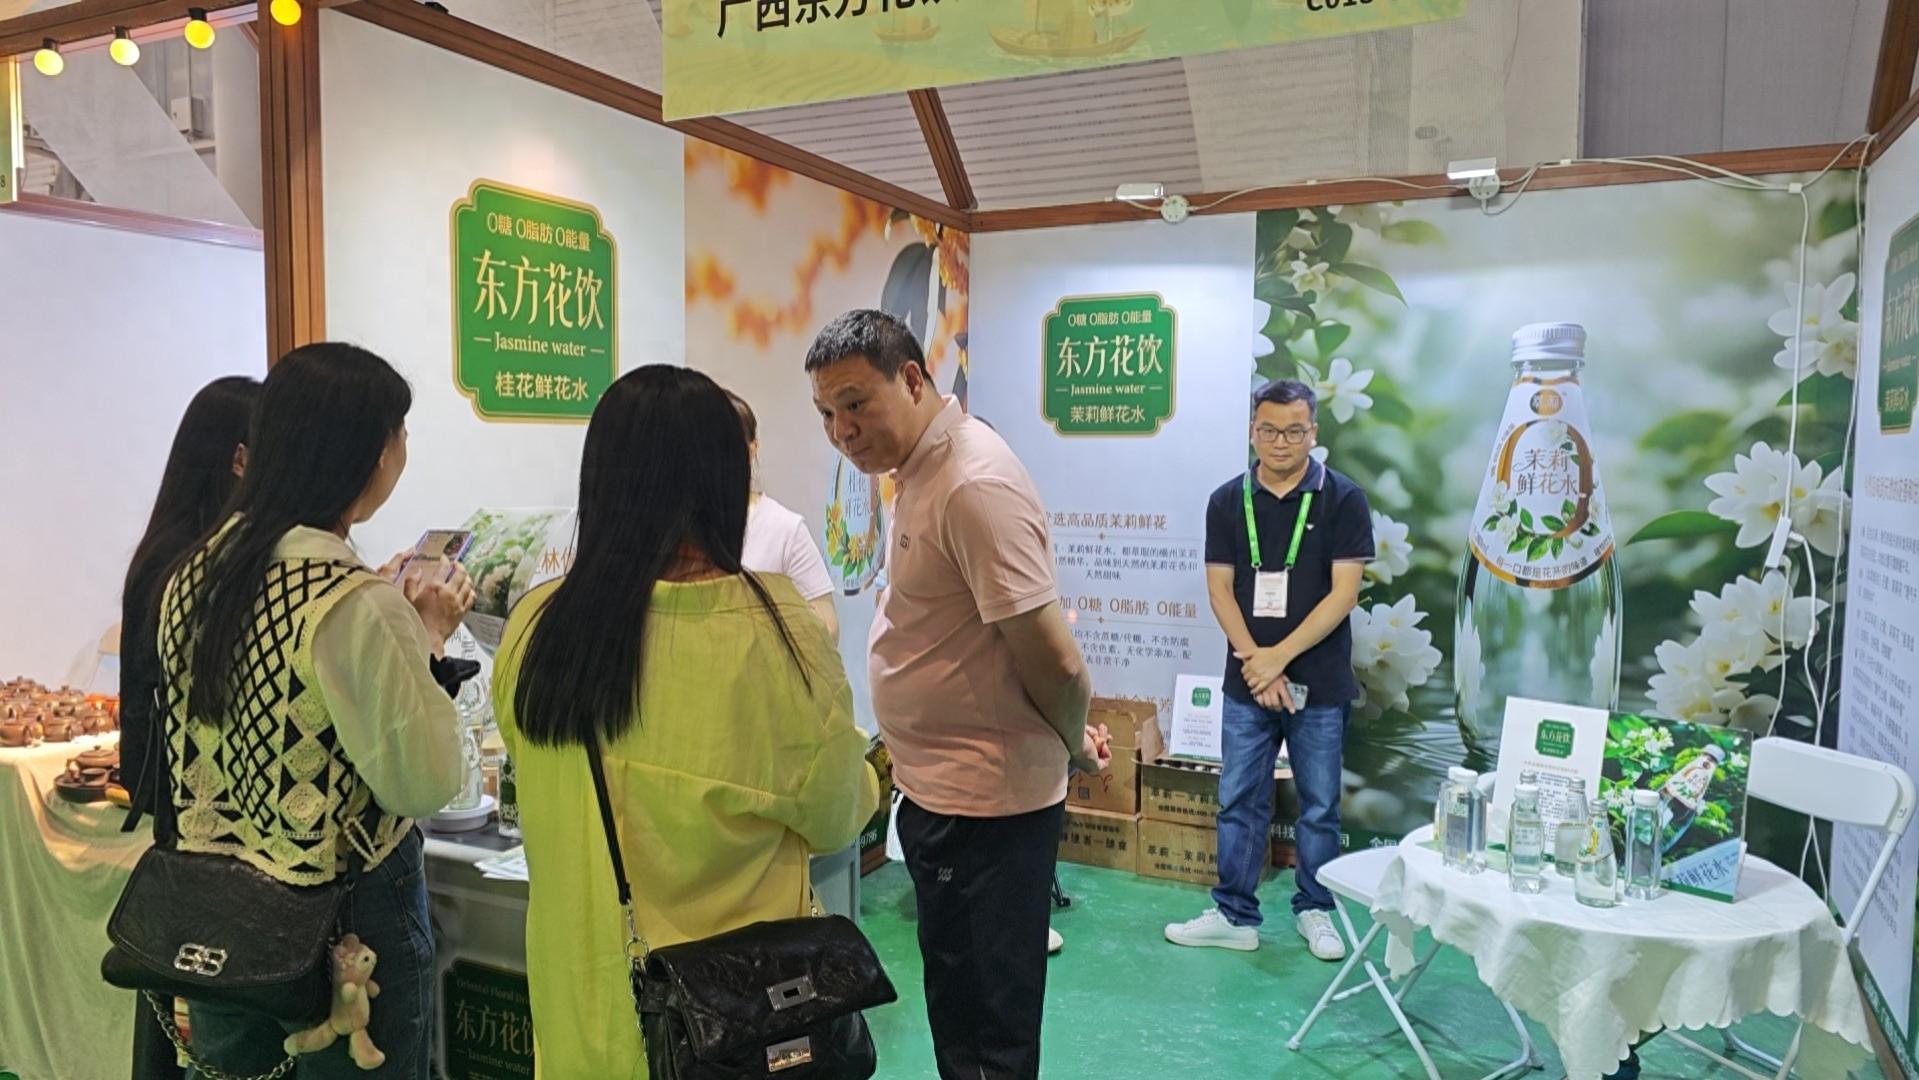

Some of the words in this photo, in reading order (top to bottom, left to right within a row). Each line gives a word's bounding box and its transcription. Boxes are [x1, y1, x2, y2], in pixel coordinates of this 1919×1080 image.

[473, 249, 605, 331] 东方花饮
[494, 331, 549, 354] Jasmine
[552, 340, 587, 357] water
[1056, 333, 1164, 379] 东方花饮
[495, 371, 589, 402] 桂花鲜花水
[1071, 383, 1113, 397] Jasmine
[1115, 384, 1146, 395] water
[1070, 403, 1146, 424] 茉莉鲜花水
[1512, 448, 1569, 473] 茉莉
[1516, 472, 1579, 496] 鲜花水
